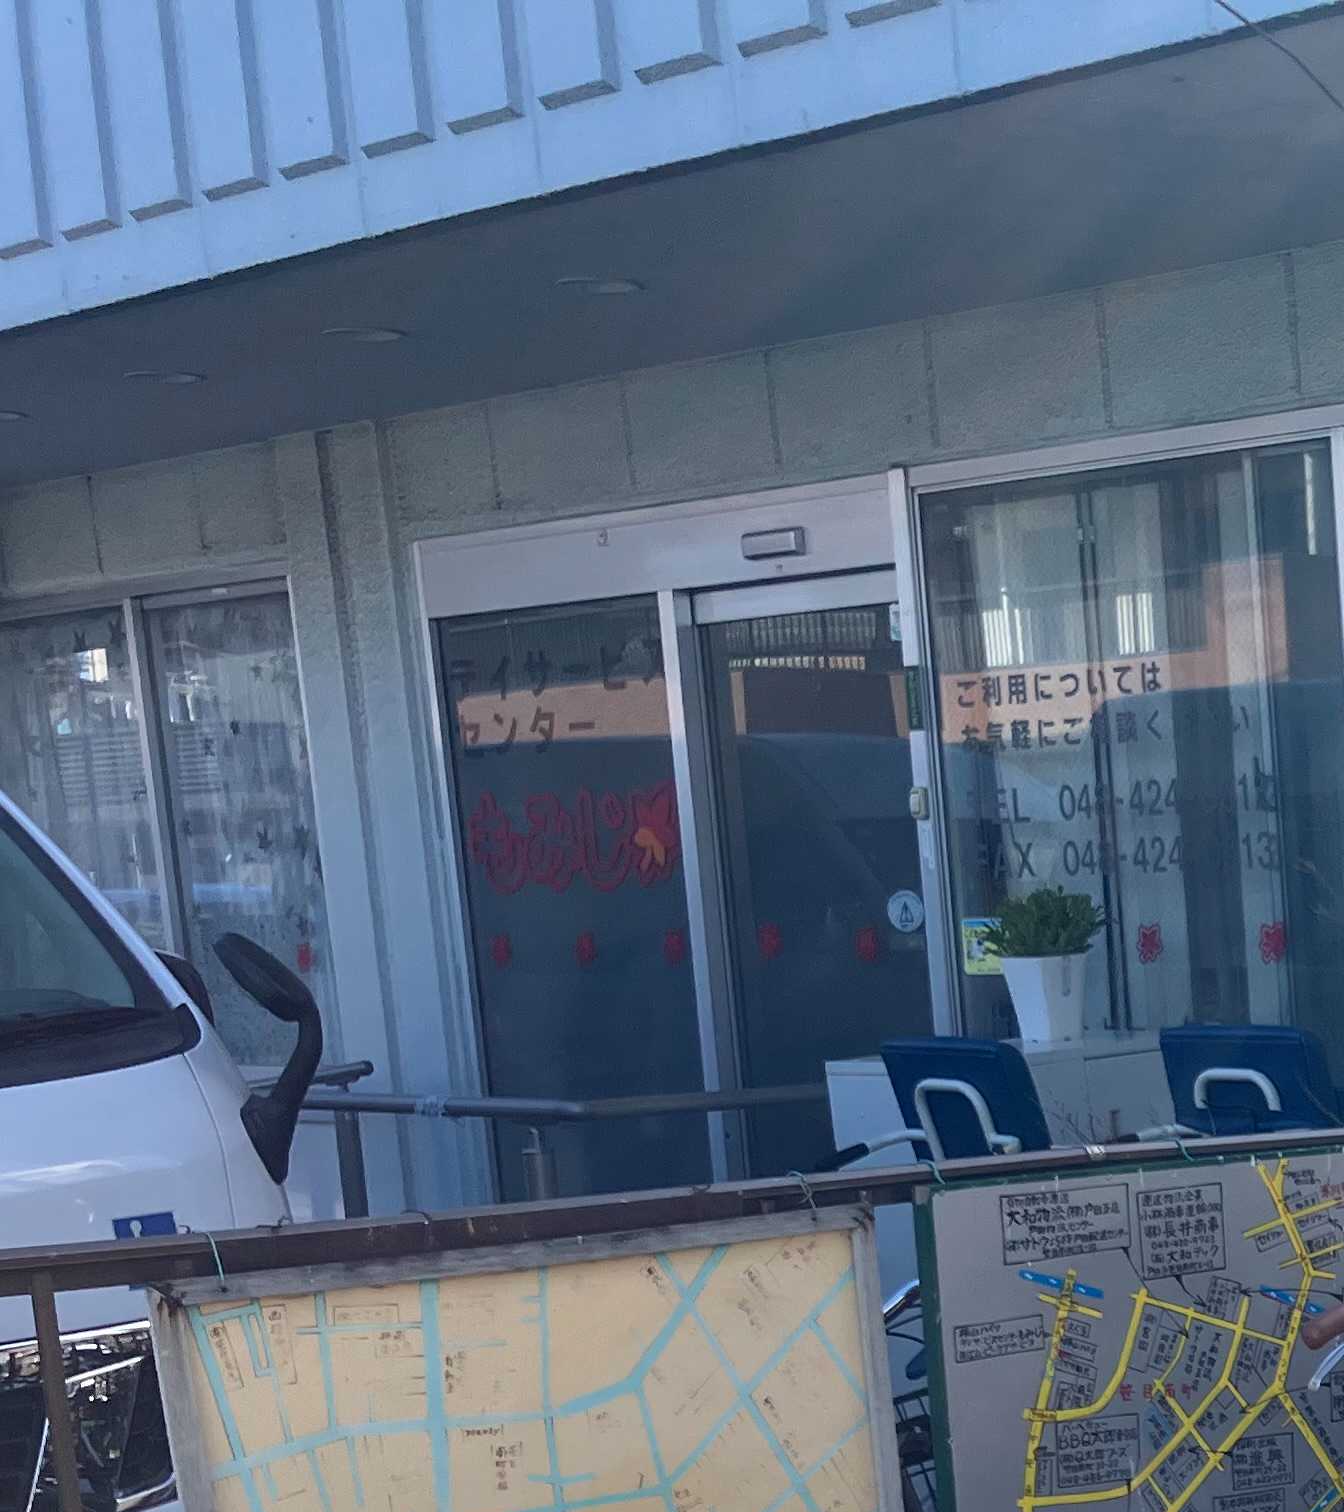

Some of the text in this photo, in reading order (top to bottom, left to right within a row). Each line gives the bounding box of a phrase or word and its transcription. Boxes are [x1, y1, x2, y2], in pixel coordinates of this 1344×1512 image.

[957, 663, 1162, 707] ご利用については
